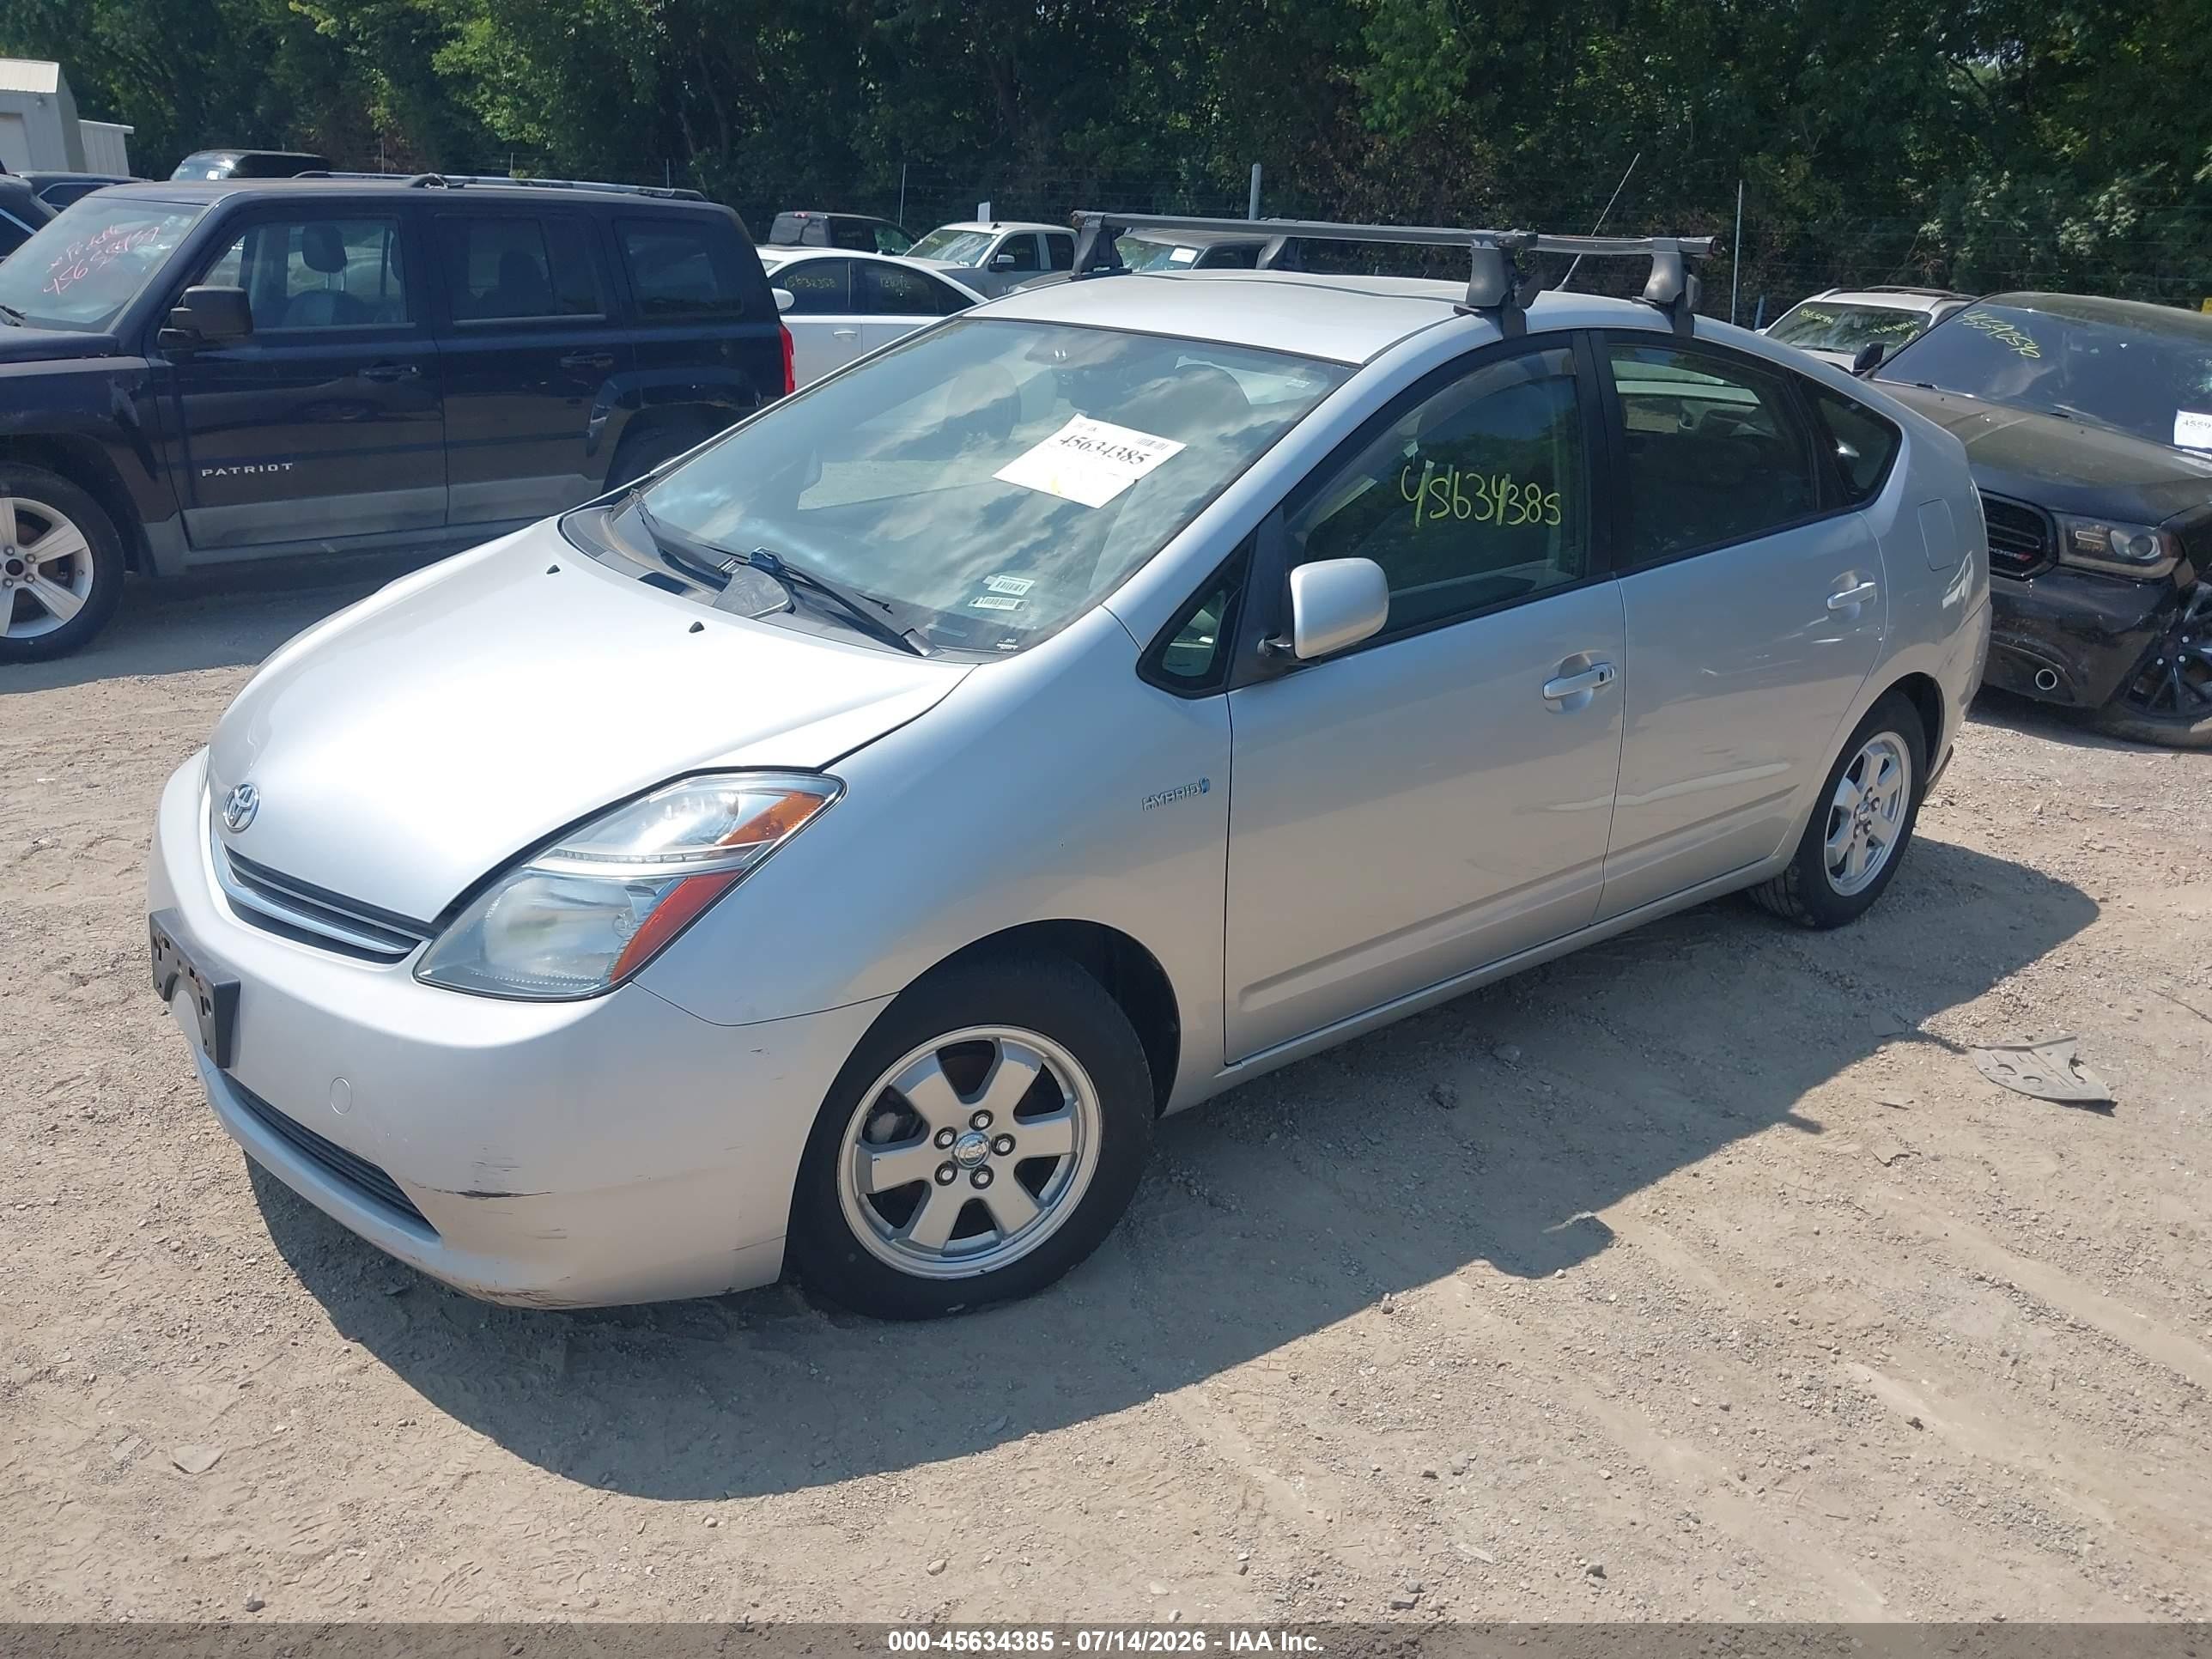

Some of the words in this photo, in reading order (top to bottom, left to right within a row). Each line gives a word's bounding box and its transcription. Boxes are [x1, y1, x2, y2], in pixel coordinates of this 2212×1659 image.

[1060, 434, 1152, 465] 45634385
[201, 463, 293, 477] PATRIOT
[1401, 464, 1561, 527] 45634385
[1141, 782, 1200, 811] HYBRID
